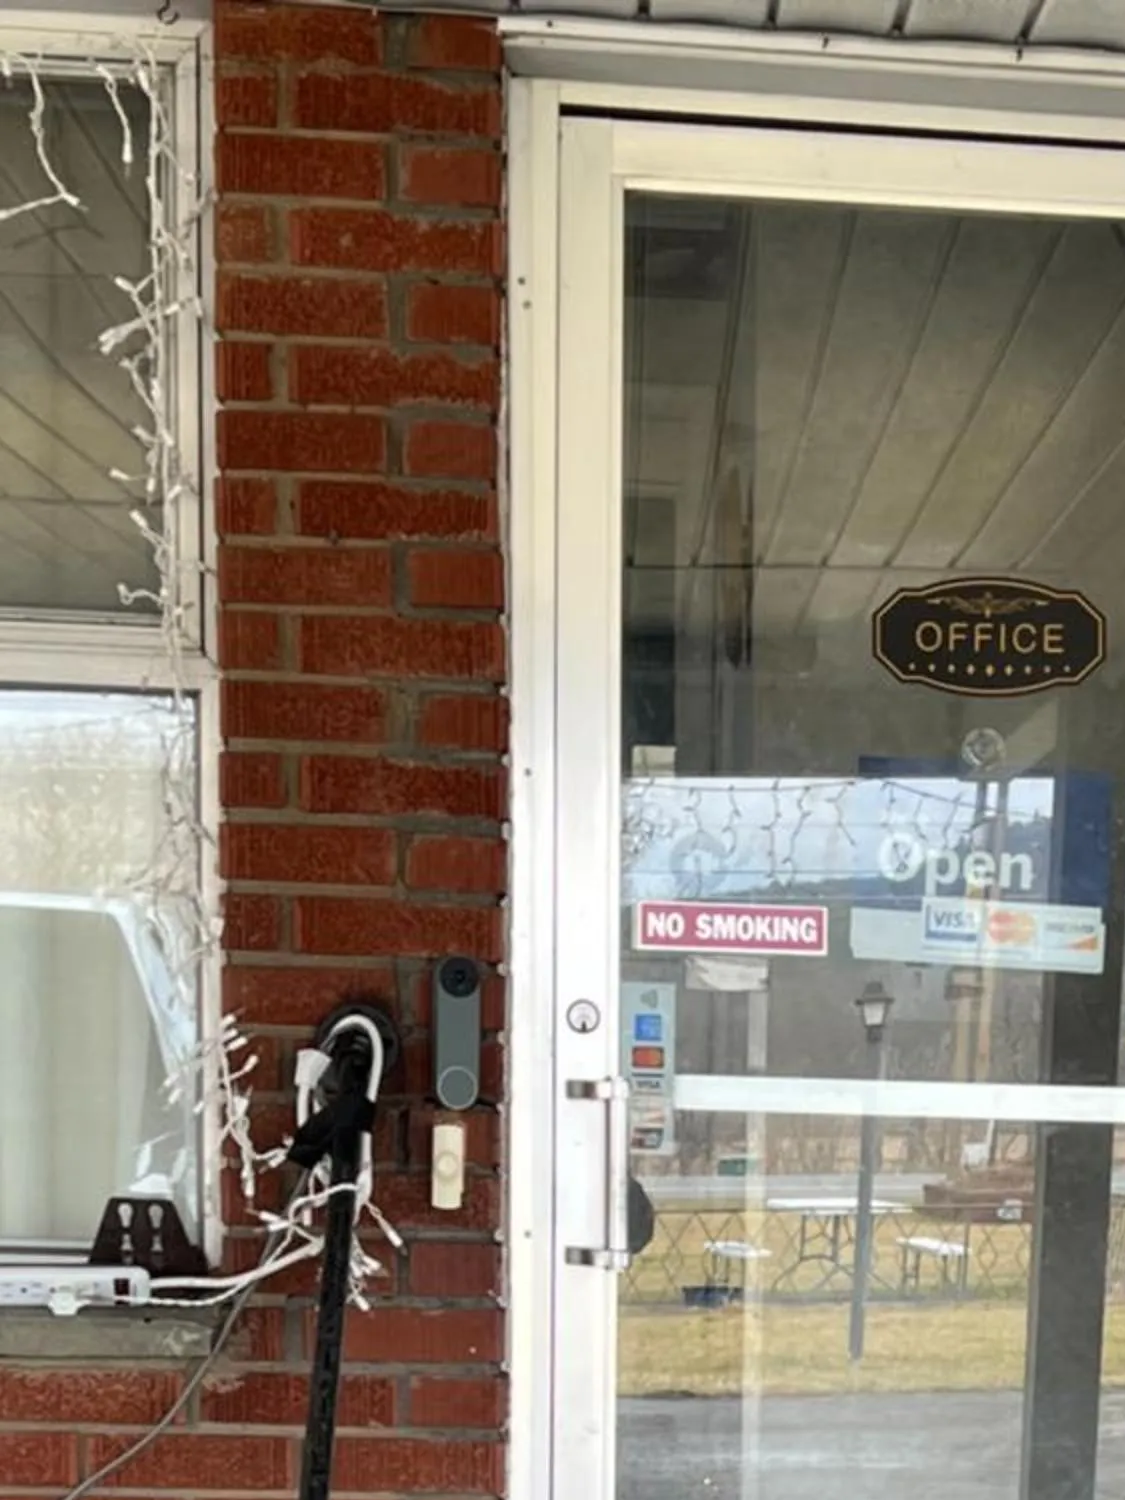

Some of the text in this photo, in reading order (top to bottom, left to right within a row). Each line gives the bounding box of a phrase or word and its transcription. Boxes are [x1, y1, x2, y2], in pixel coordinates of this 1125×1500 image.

[914, 620, 1065, 654] OFFICE
[878, 832, 1036, 898] Open
[646, 911, 818, 943] NO SMOKING
